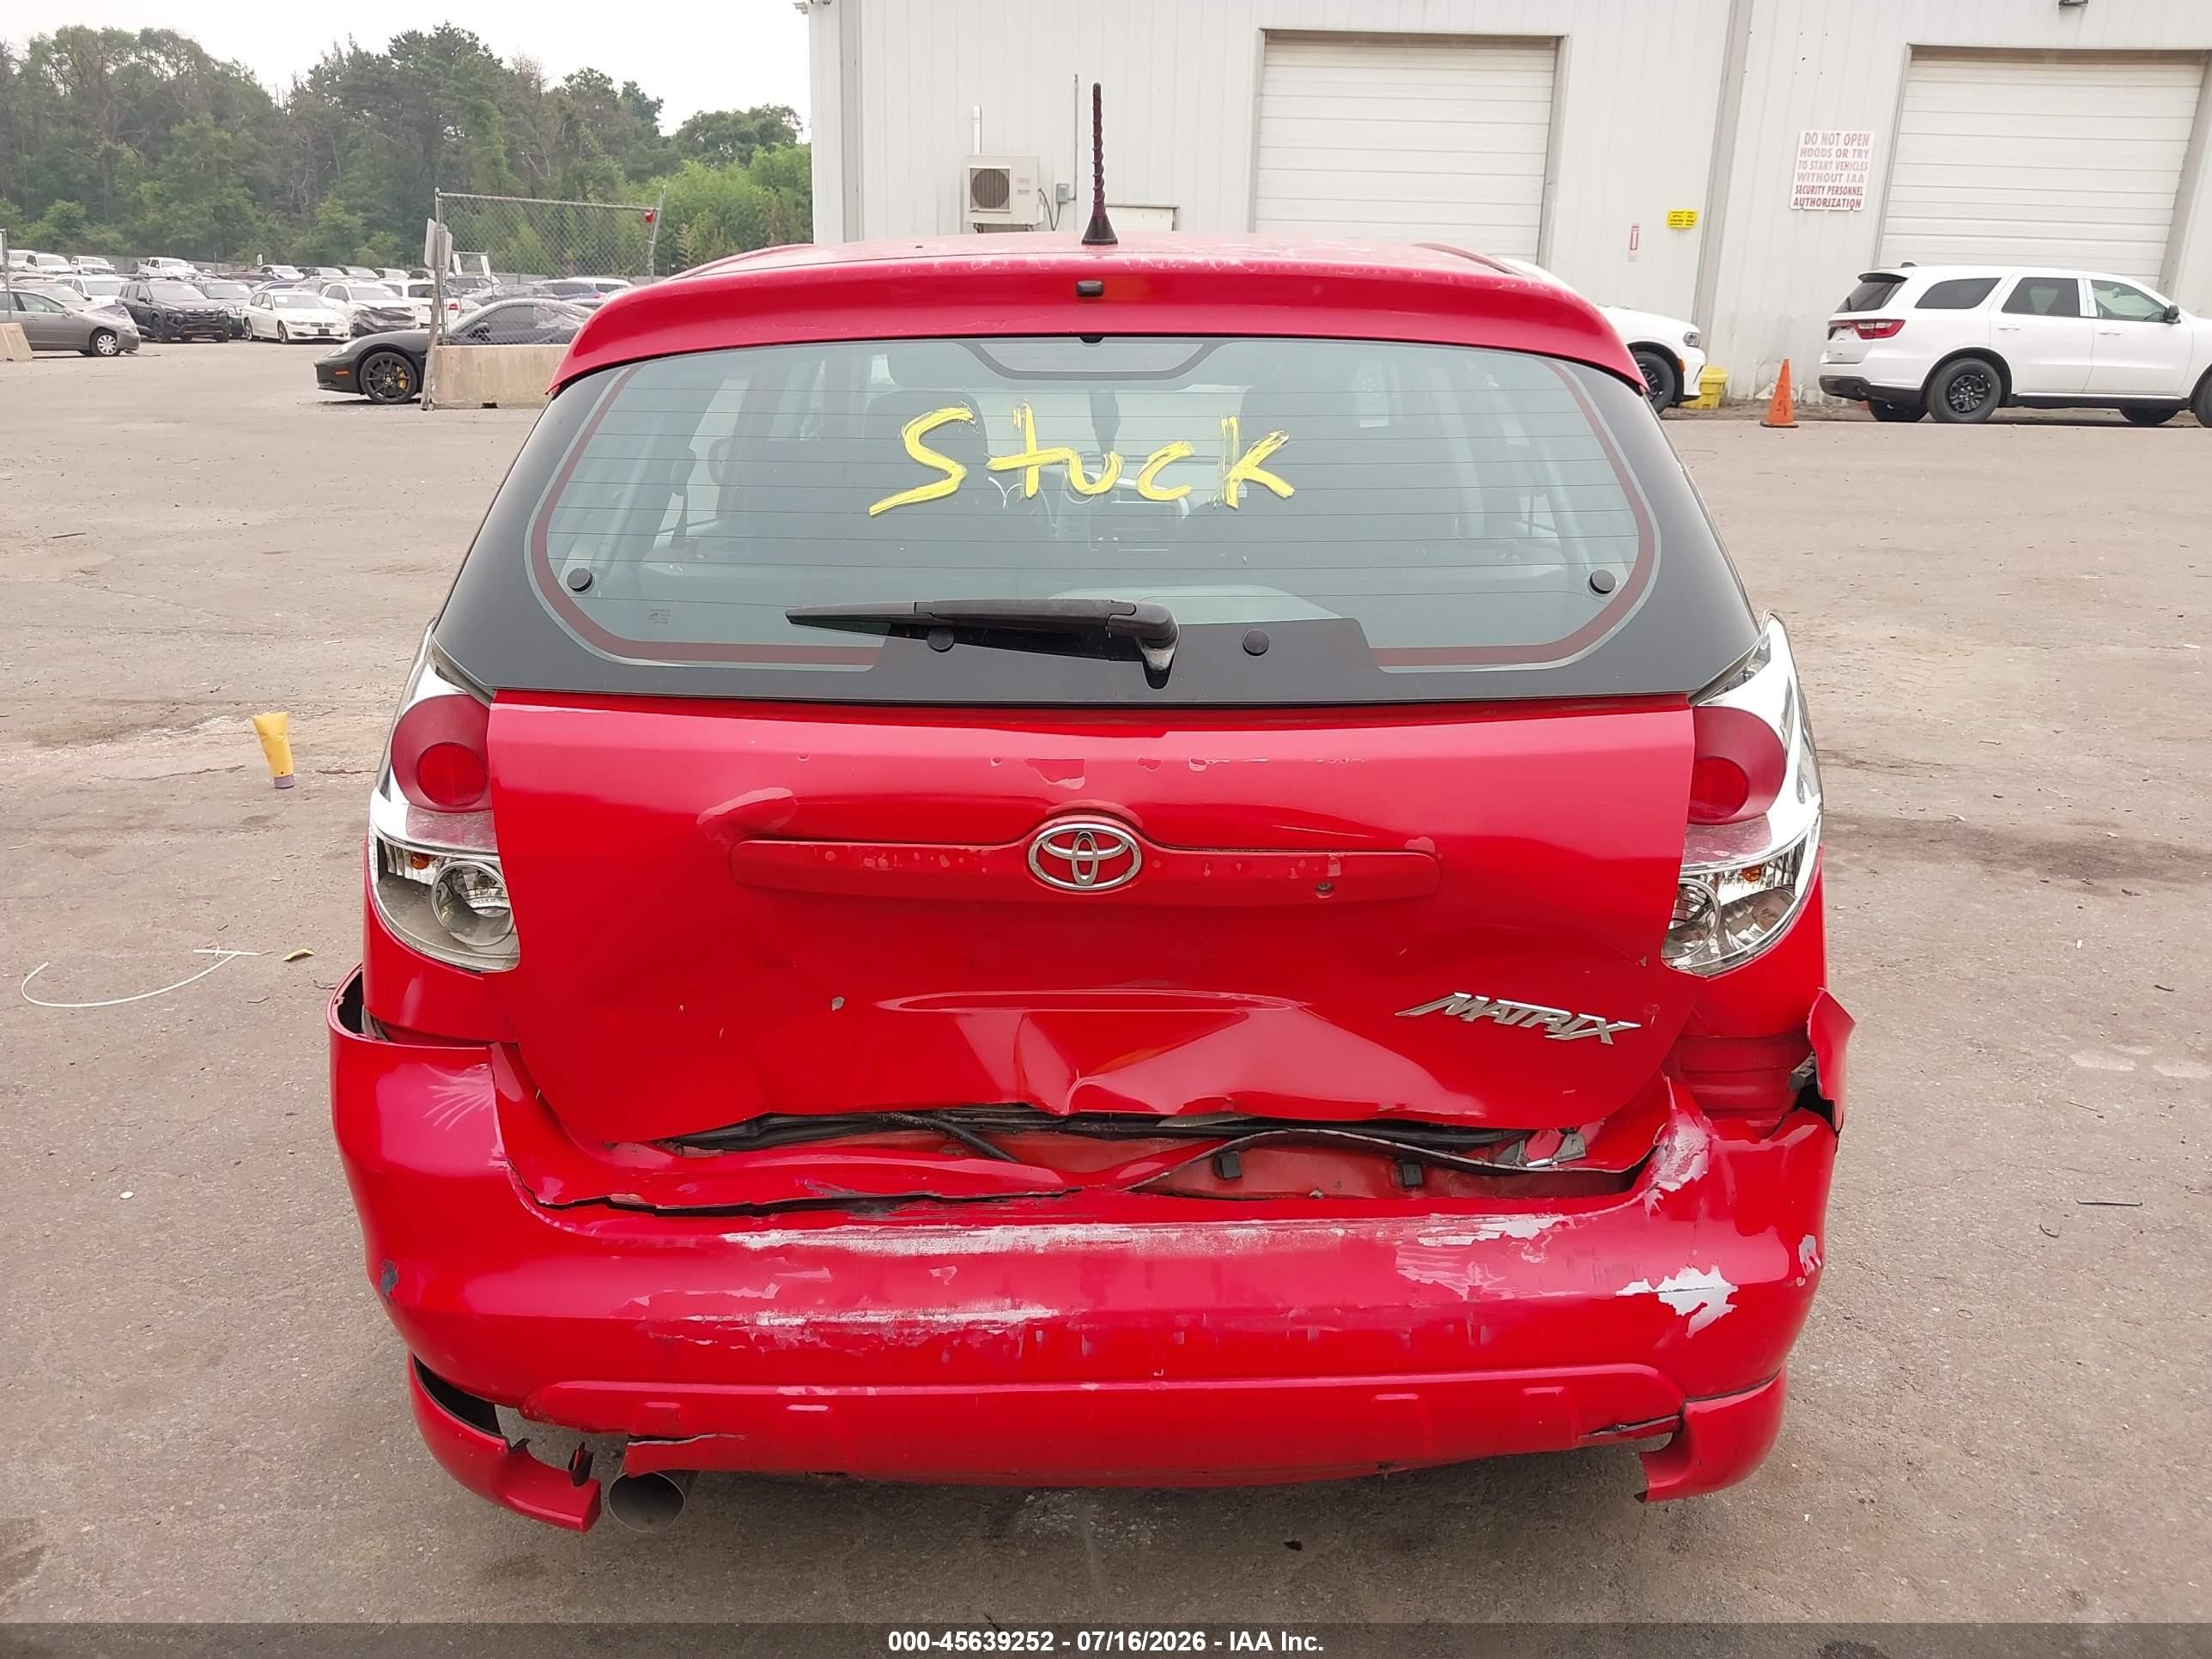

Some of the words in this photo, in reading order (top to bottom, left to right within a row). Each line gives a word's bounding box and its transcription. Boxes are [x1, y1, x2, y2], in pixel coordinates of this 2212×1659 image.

[1804, 132, 1818, 145] DO
[1821, 132, 1839, 146] NOT
[1843, 133, 1869, 147] OPEN
[1800, 148, 1832, 158] HOODS
[1835, 149, 1848, 159] OR
[1852, 149, 1869, 159] TRY
[1798, 161, 1808, 171] TO
[1809, 161, 1833, 171] START
[1835, 161, 1869, 172] VEHICLES
[1796, 173, 1843, 183] WITHOUT
[1846, 173, 1864, 184] IAA
[1795, 185, 1826, 195] SECURITY
[1826, 186, 1863, 196] PERSONNEL
[1793, 198, 1862, 208] AUTHORIZATION
[1395, 992, 1643, 1045] MATRIX
